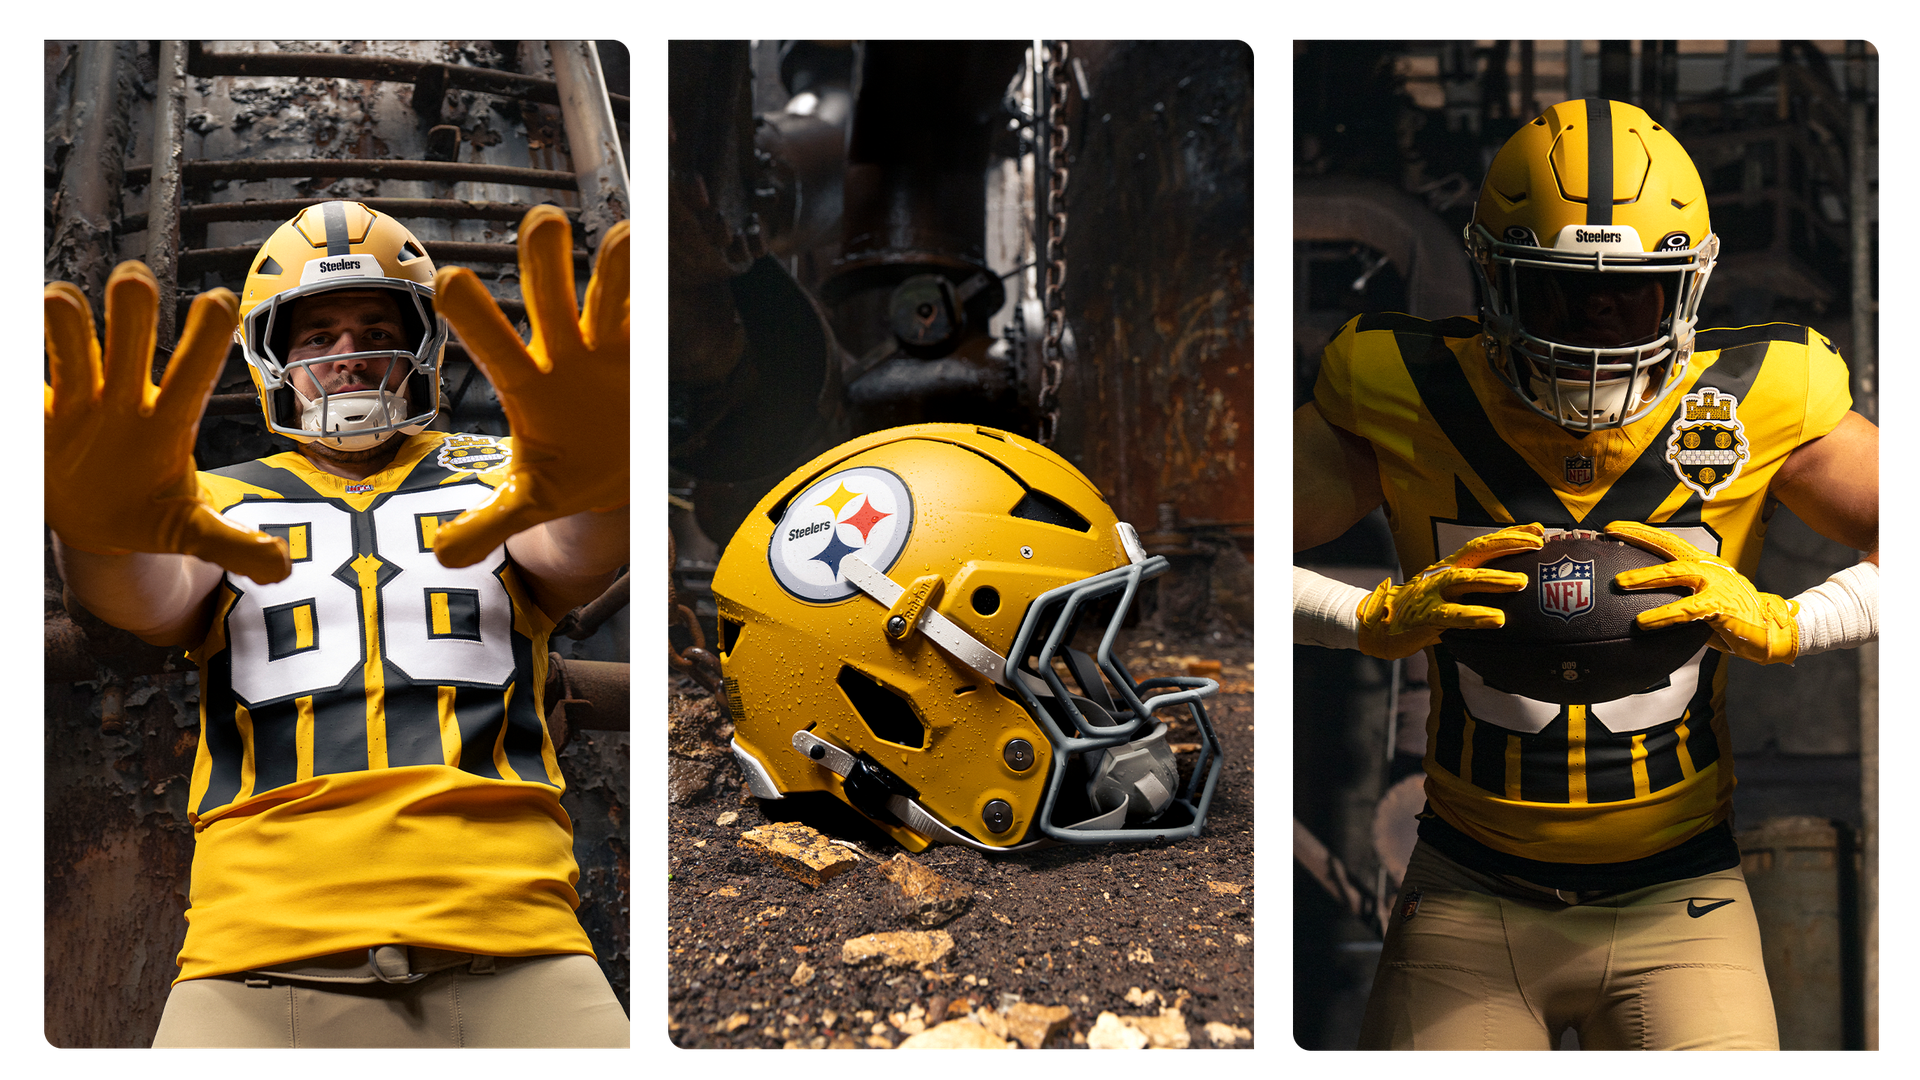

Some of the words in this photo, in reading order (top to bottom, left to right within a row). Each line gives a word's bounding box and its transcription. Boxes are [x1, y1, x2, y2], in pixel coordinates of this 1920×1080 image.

[1575, 228, 1622, 243] Steelers
[319, 258, 361, 273] Steelers
[1569, 469, 1590, 482] NFL
[788, 520, 831, 541] Steelers
[221, 482, 518, 708] 88
[1544, 581, 1589, 613] NFL
